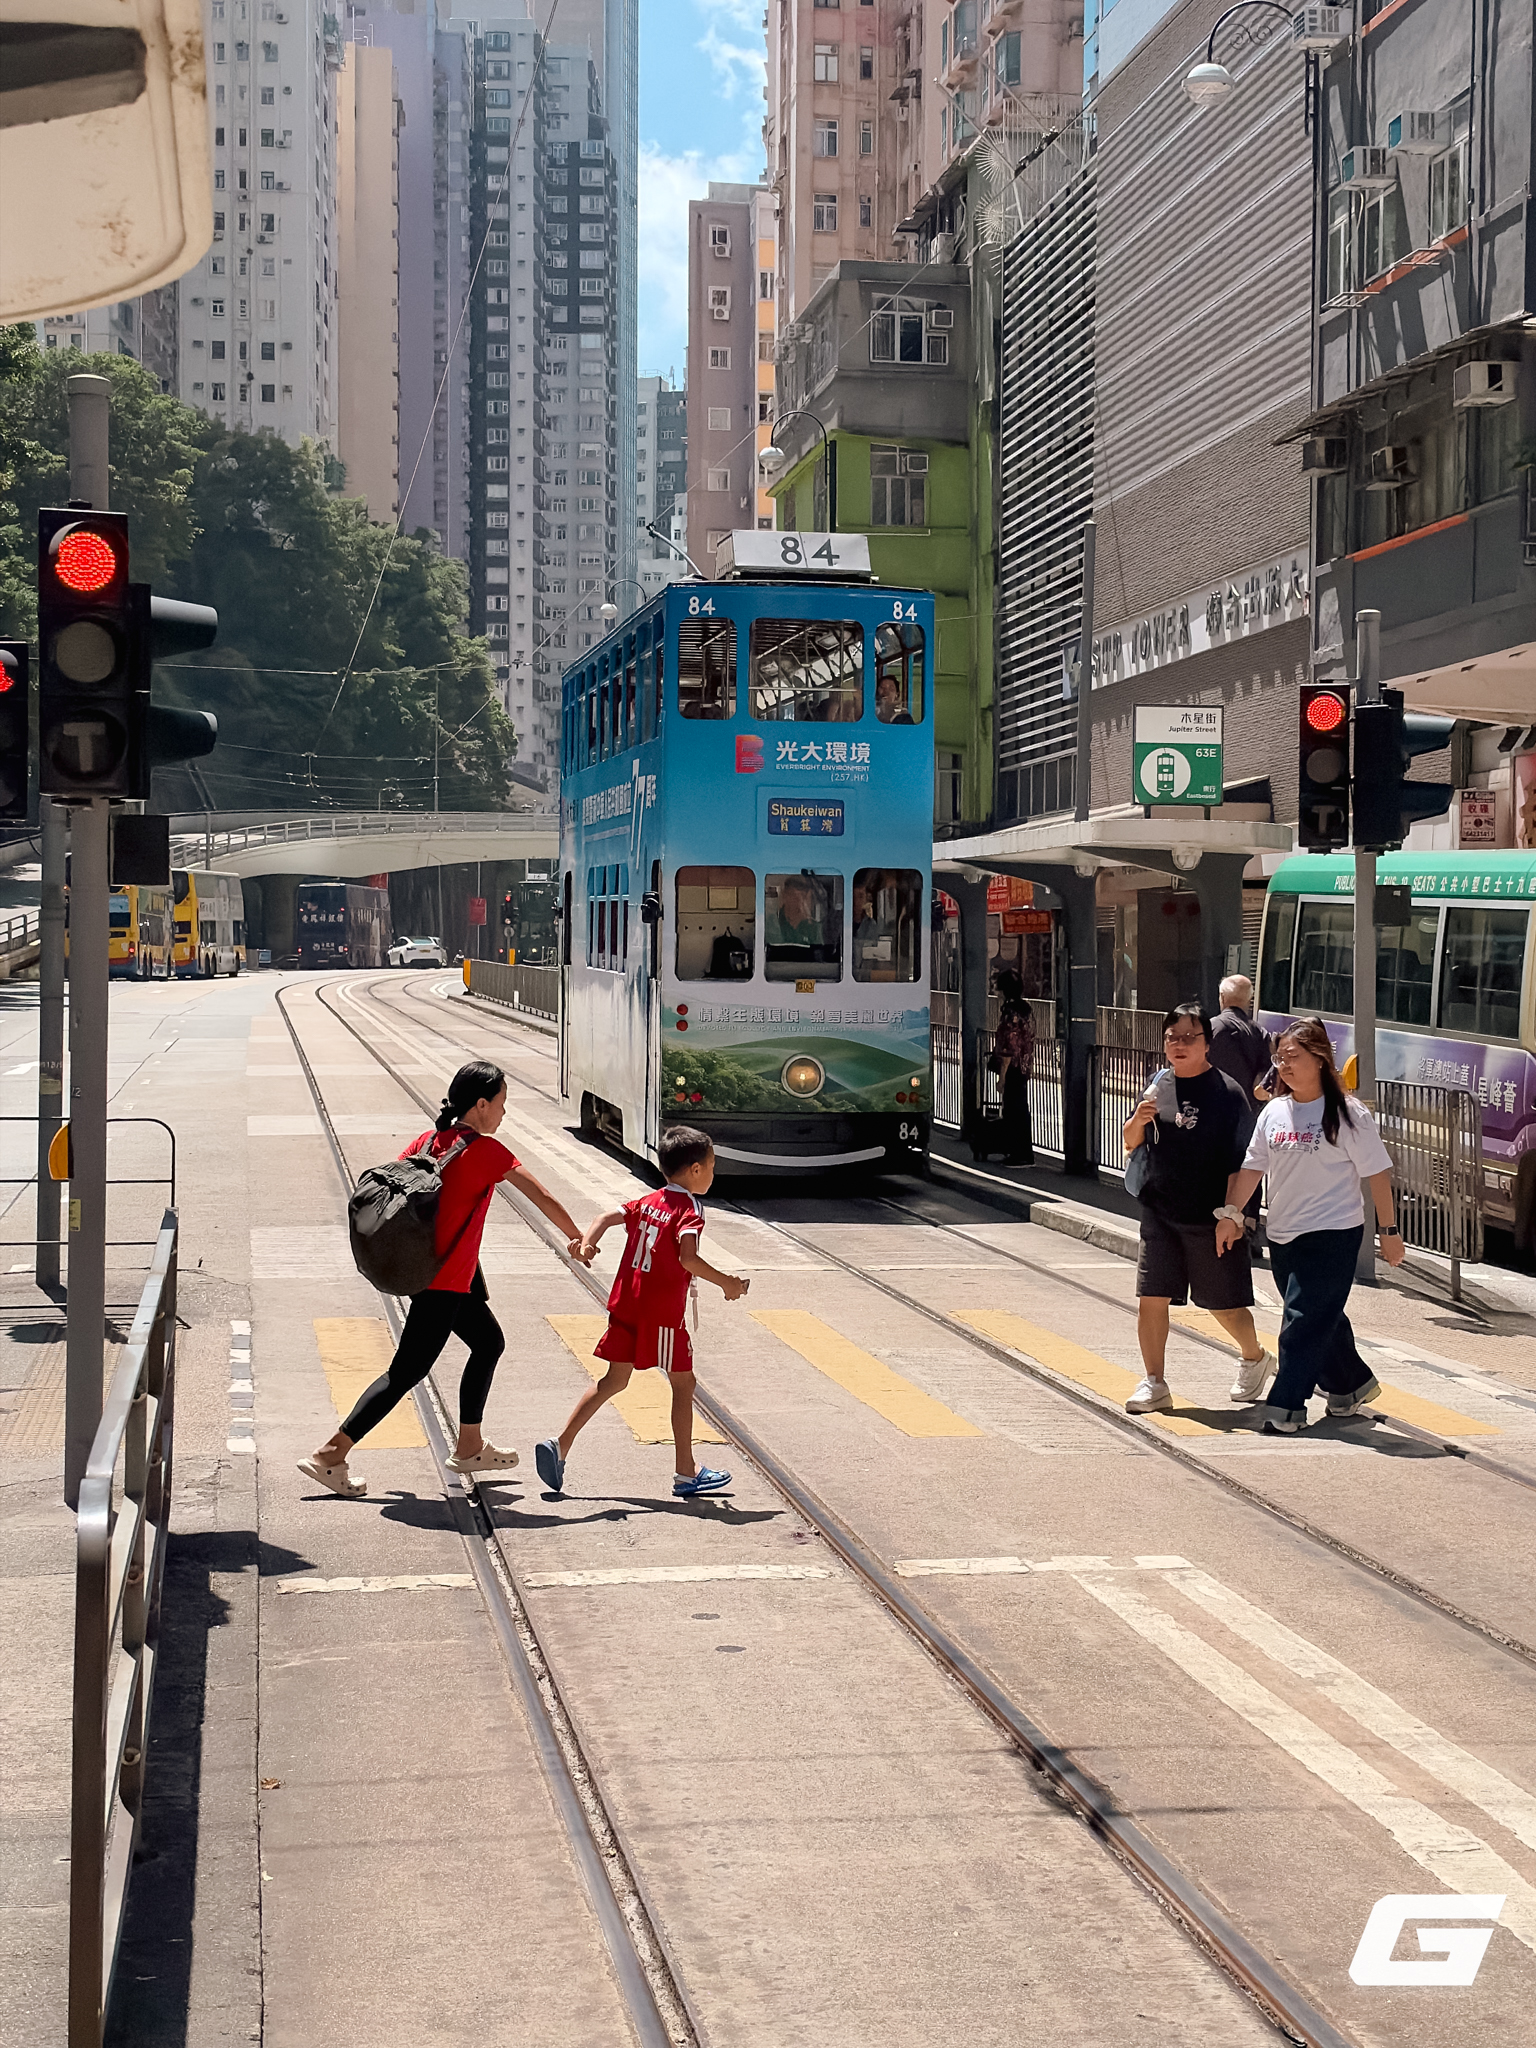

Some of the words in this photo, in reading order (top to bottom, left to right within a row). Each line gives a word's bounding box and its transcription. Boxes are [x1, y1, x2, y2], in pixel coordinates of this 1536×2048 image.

[781, 536, 840, 566] 84
[688, 597, 716, 616] 84
[892, 601, 917, 621] 84
[1131, 603, 1190, 664] TOWER
[1180, 712, 1217, 725] 木星街
[1168, 725, 1193, 733] Jupiter
[775, 740, 871, 764] 光大環境
[1195, 748, 1217, 758] 63E
[821, 764, 870, 772] ENVIRONMENT
[830, 773, 869, 782] (257.HK)
[771, 803, 842, 818] Shaukeiwan
[1412, 875, 1437, 892] SEATS
[899, 1122, 919, 1140] 84
[640, 1203, 672, 1223] M.SALAH
